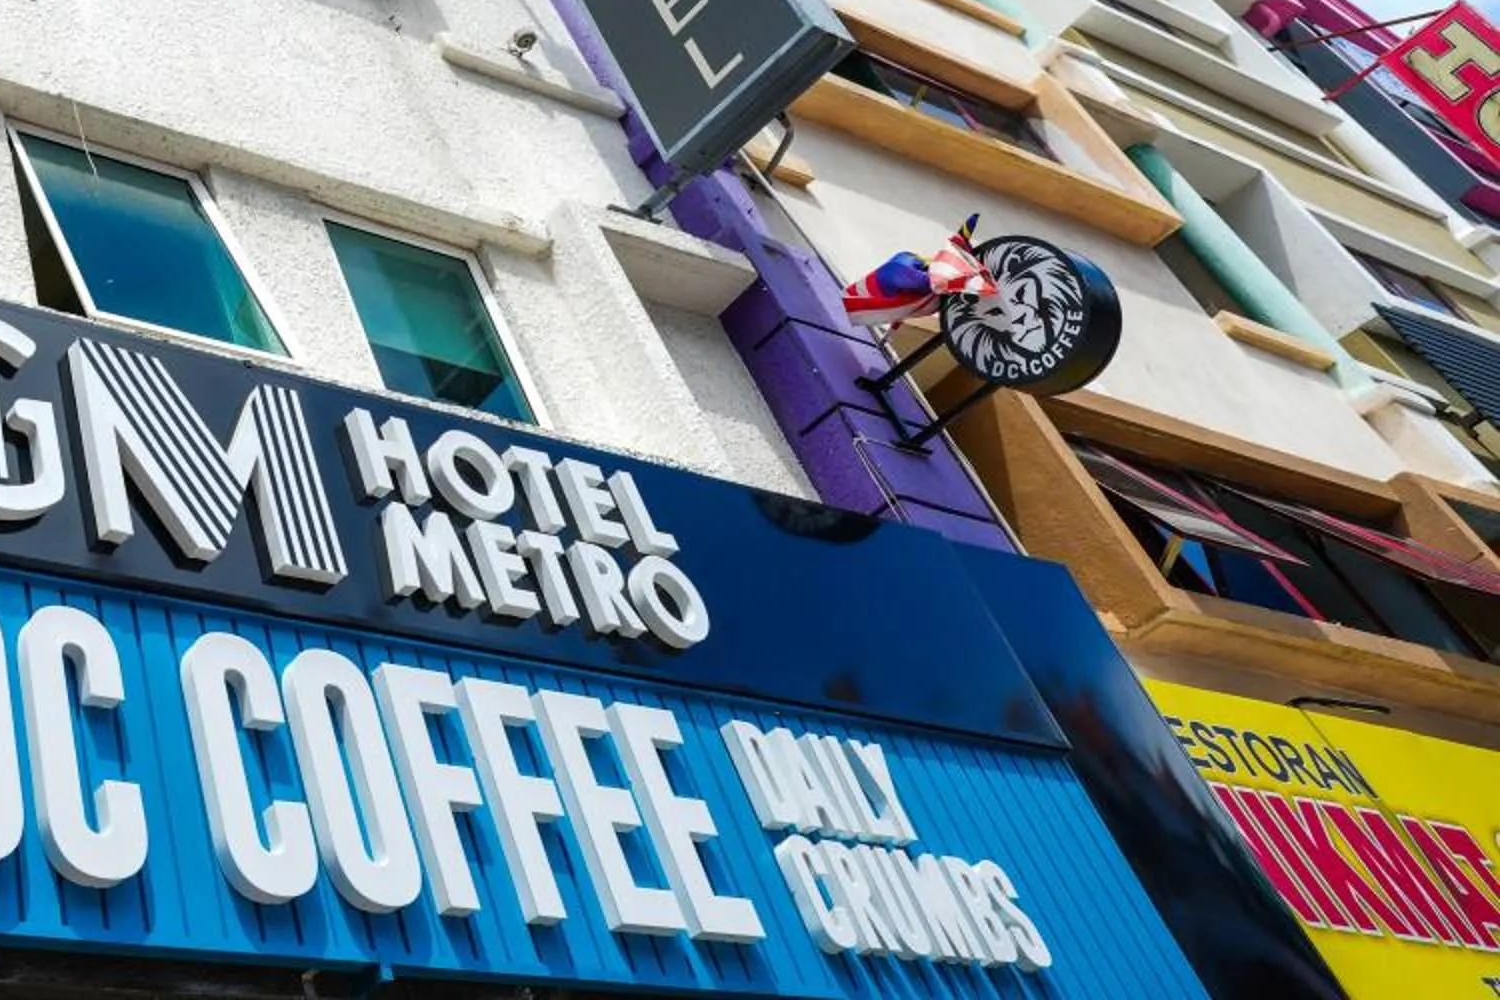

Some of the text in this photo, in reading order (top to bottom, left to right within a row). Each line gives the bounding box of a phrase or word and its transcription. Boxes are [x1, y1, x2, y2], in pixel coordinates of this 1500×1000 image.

[991, 309, 1083, 379] DC COFFEE
[343, 406, 681, 556] HOTEL
[379, 502, 710, 650] METRO
[180, 631, 766, 943] COFFEE
[720, 719, 918, 846] DAILY
[774, 834, 1052, 972] CRUMBS
